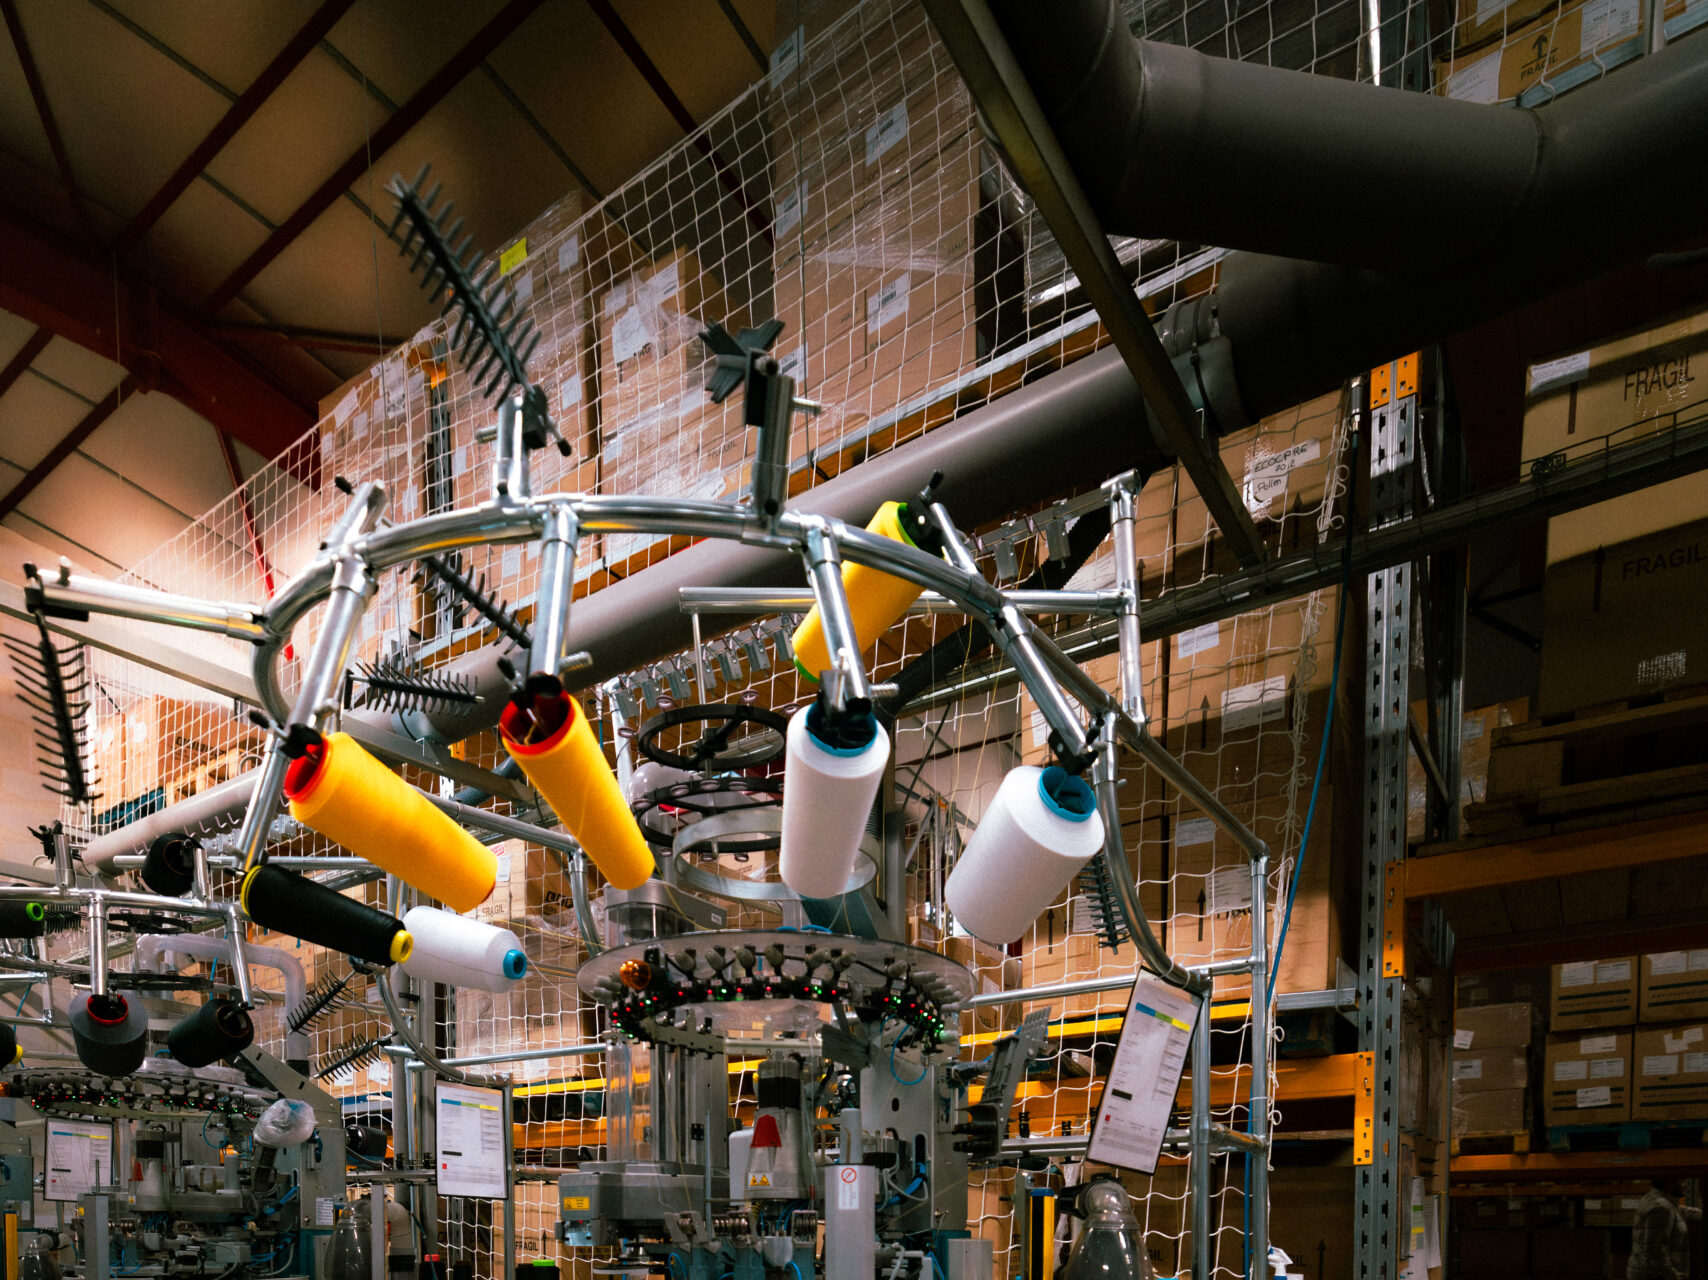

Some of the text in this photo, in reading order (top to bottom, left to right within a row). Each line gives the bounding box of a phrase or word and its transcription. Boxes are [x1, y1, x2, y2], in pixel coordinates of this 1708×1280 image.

[1624, 353, 1695, 402] FRAGIL
[1622, 543, 1707, 580] FRAGIL
[482, 903, 505, 917] FRAGIL
[533, 1015, 556, 1030] FRAGIL
[515, 1240, 539, 1252] FRAGIL
